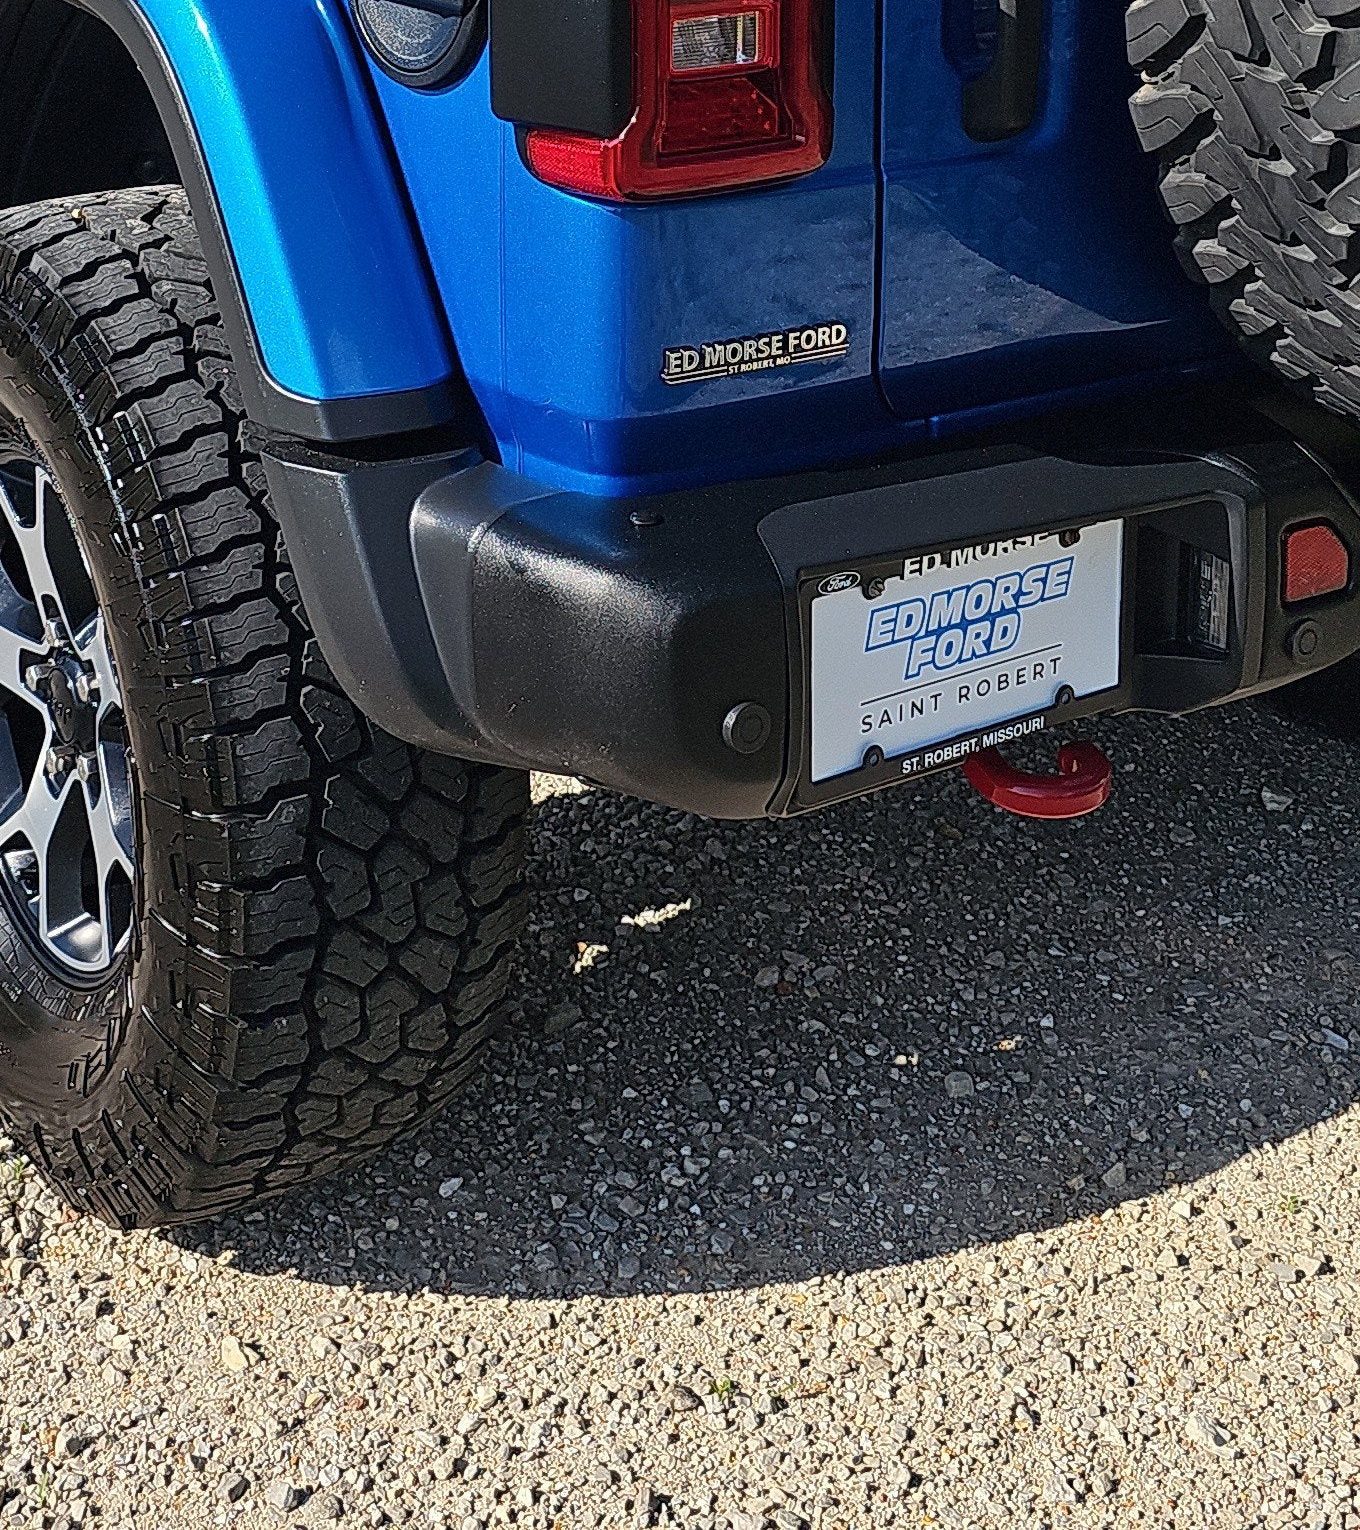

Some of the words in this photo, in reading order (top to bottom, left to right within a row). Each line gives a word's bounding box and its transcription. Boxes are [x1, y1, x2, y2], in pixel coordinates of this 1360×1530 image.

[665, 349, 700, 374] ED
[702, 334, 784, 368] MORSE
[788, 324, 847, 354] FORD
[776, 356, 791, 366] MO
[903, 552, 941, 581] ED
[904, 611, 1022, 680] FORD
[861, 693, 943, 734] SAINT
[958, 656, 1062, 704] ROBERT
[902, 757, 921, 774] ST.
[924, 738, 980, 768] ROBERT,
[982, 716, 1045, 750] MISSOURI
